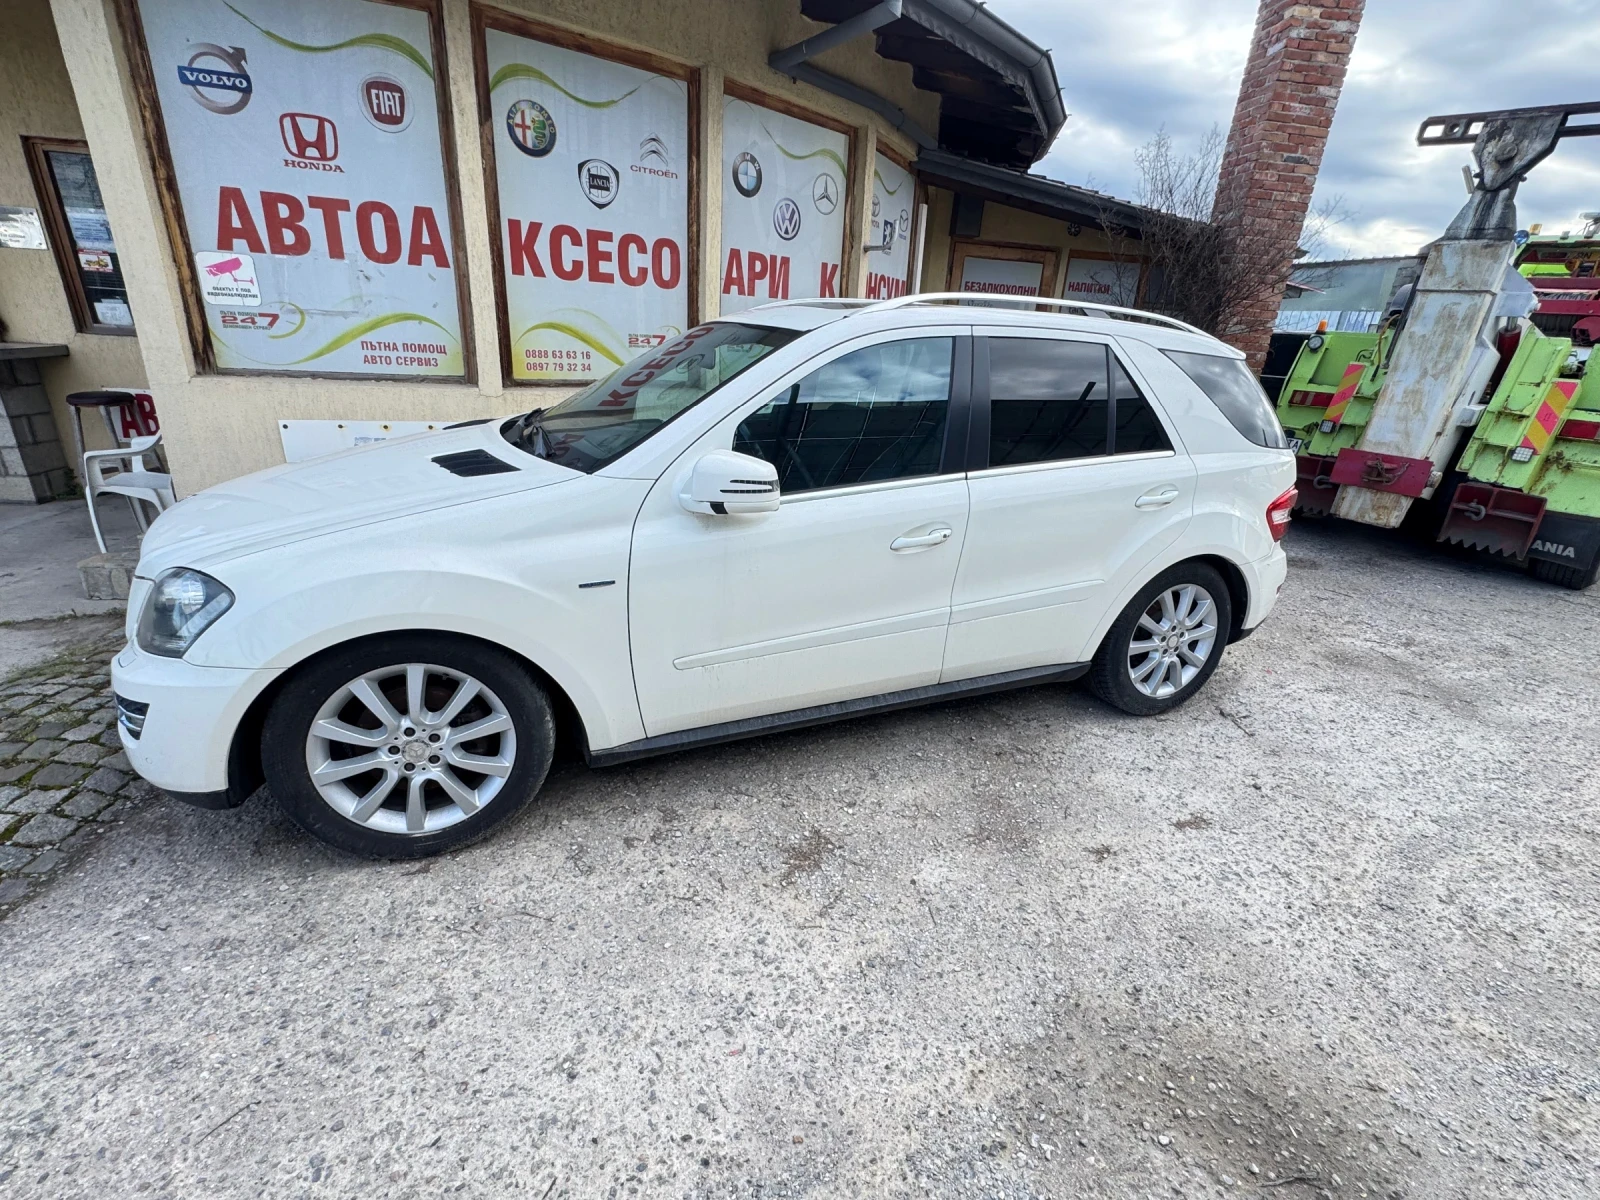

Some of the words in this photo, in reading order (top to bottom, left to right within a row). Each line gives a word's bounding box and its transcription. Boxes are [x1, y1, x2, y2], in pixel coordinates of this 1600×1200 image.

[182, 71, 248, 89] VOLVO
[370, 89, 401, 117] FIAT
[283, 159, 345, 173] HONDA
[590, 177, 610, 188] LANCIA
[216, 185, 451, 269] АВТОА
[507, 218, 681, 290] КСЕСО
[722, 248, 790, 300] АРИ
[964, 281, 1037, 297] БЕЗАЛКОХОЛНИ
[1068, 282, 1111, 295] НАПИТКИ
[361, 340, 399, 352] ПЪТНА
[402, 343, 448, 356] ПОМОЩ
[525, 349, 549, 359] 0888
[551, 350, 564, 359] 63
[566, 350, 578, 360] 63
[580, 351, 592, 360] 16
[363, 354, 392, 366] АВТО
[395, 356, 439, 367] СЕРВИЗ
[526, 362, 550, 371] 0897
[552, 362, 564, 372] 79
[567, 362, 578, 372] 32
[580, 363, 592, 372] 34
[1531, 540, 1575, 558] ANIA
